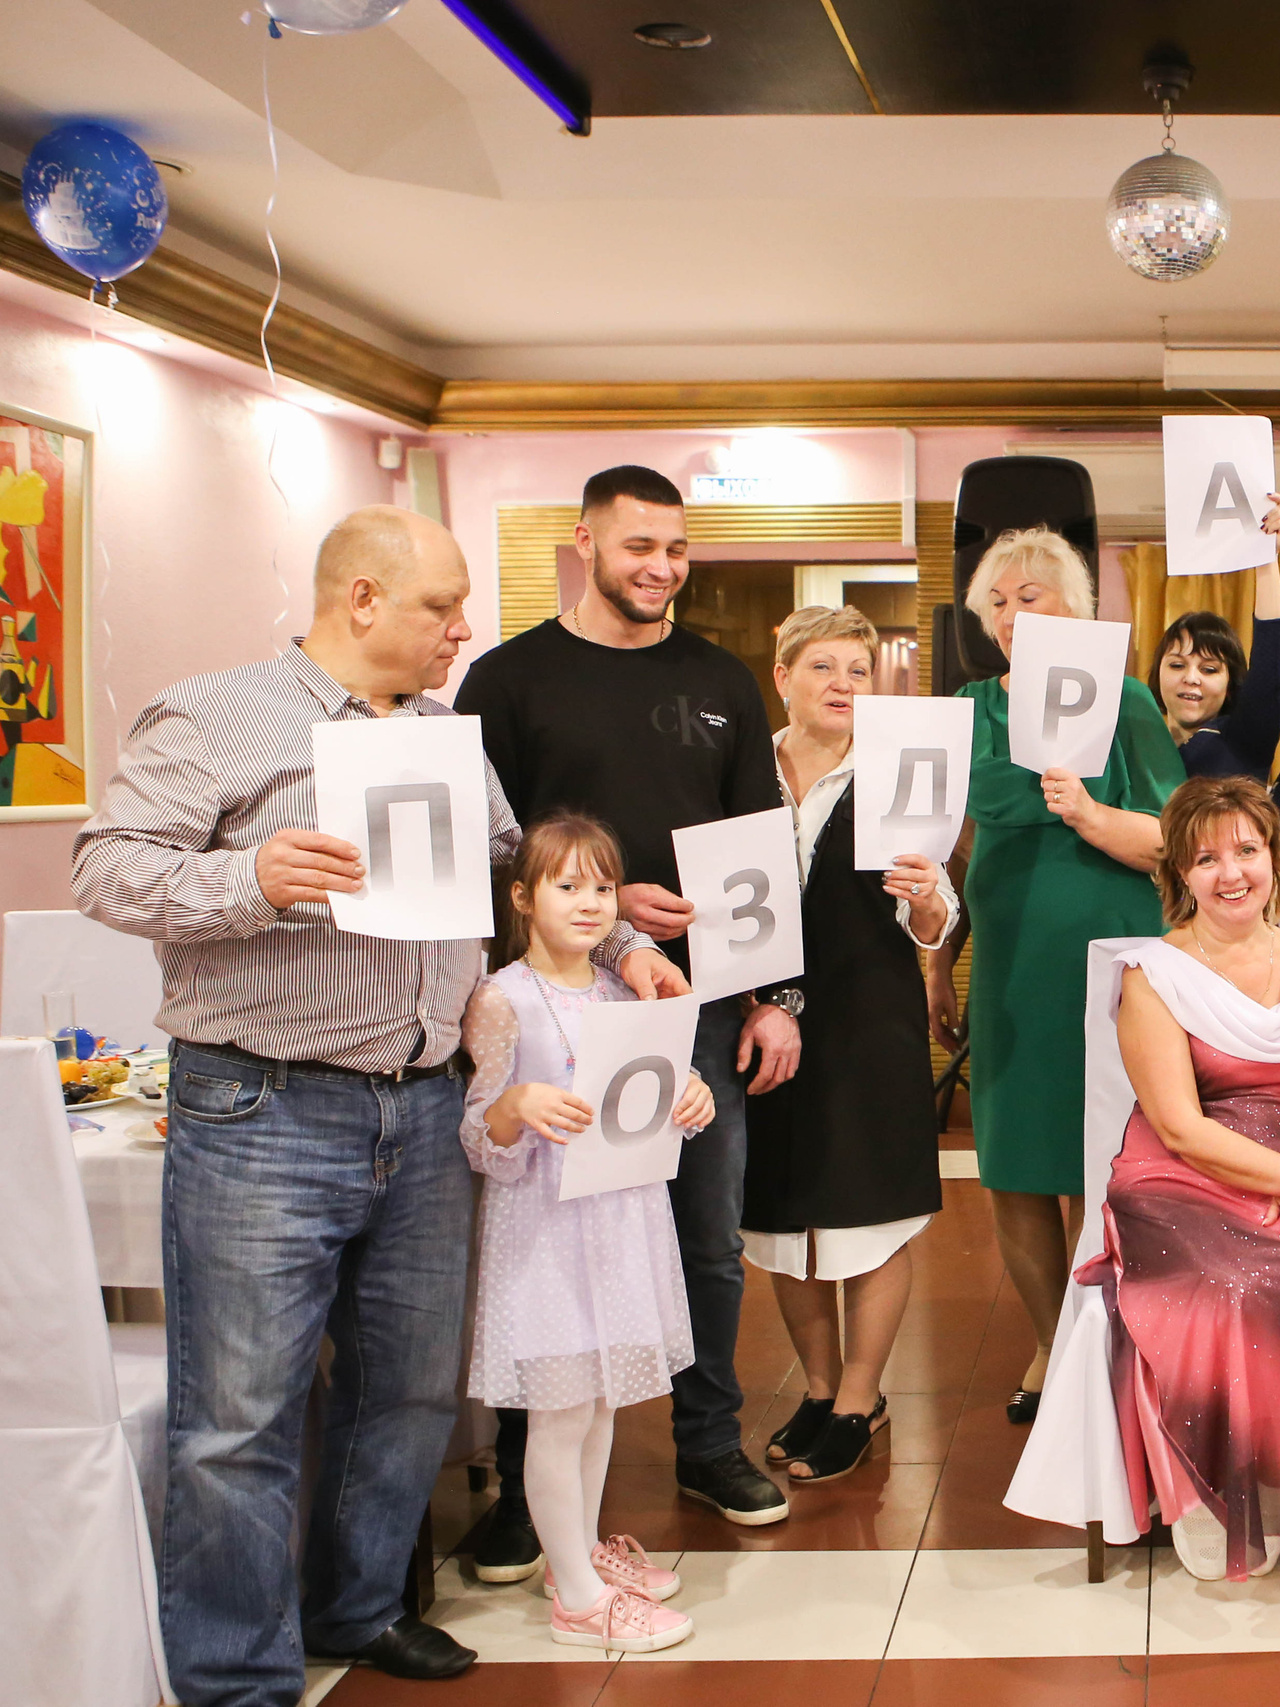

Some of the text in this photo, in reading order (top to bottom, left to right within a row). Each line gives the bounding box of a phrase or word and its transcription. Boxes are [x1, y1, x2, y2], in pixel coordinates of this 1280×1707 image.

[1195, 462, 1261, 537] А
[1042, 666, 1098, 742] Р
[880, 747, 953, 829] Д
[364, 782, 456, 891] П
[722, 867, 777, 955] З
[600, 1055, 677, 1147] О
